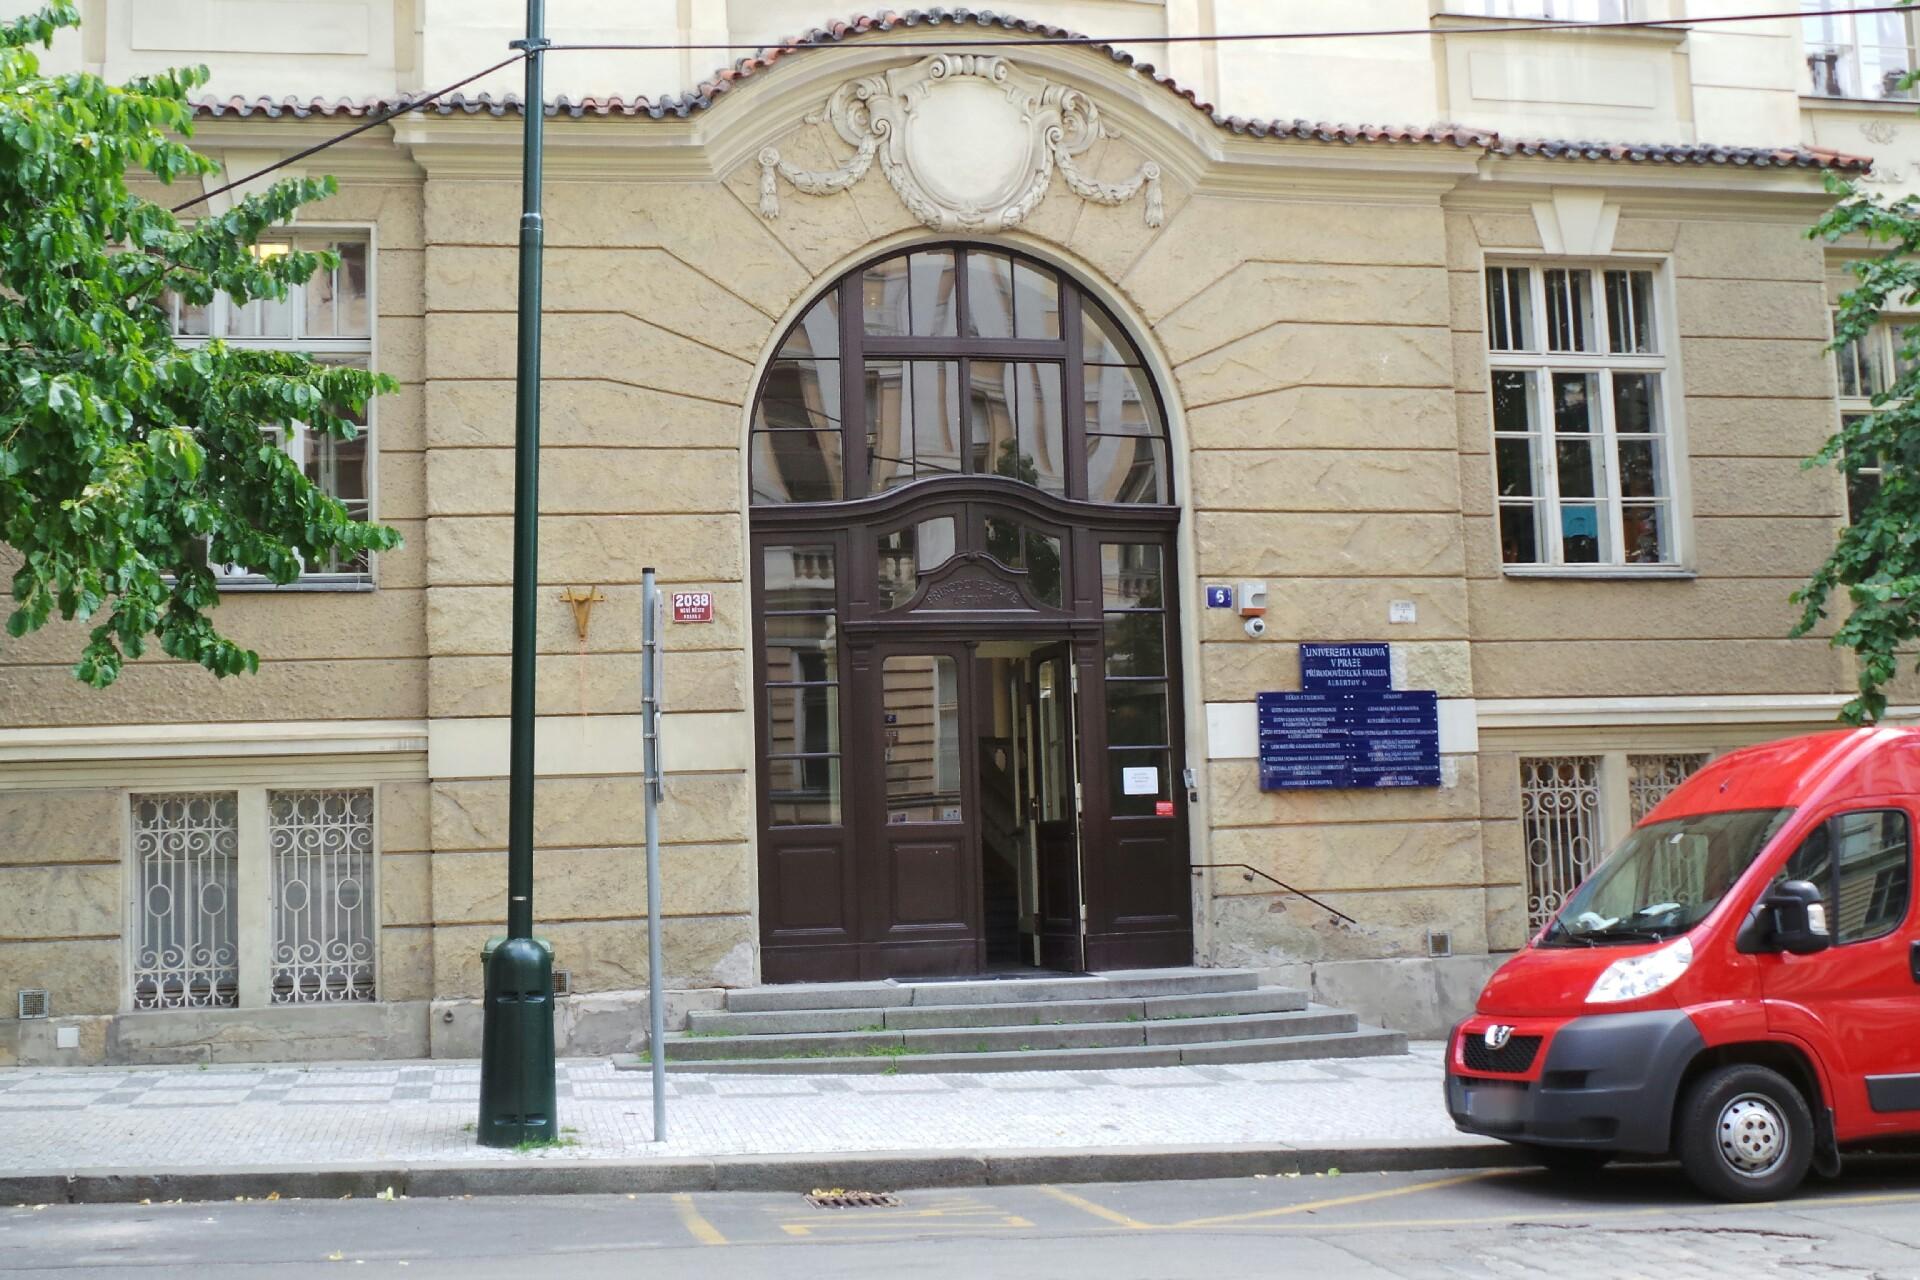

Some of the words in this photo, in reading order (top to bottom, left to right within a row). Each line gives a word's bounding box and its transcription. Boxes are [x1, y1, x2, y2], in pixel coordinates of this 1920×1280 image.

[676, 595, 708, 607] 2038
[1306, 647, 1351, 657] UNIVERZITA
[1352, 647, 1386, 656] KARLOVA
[1331, 658, 1336, 667] V
[1337, 658, 1362, 667] PRAZE
[1306, 668, 1361, 677] PŘÍRODOVĚDECKÁ
[1362, 668, 1387, 677] FAKULTA
